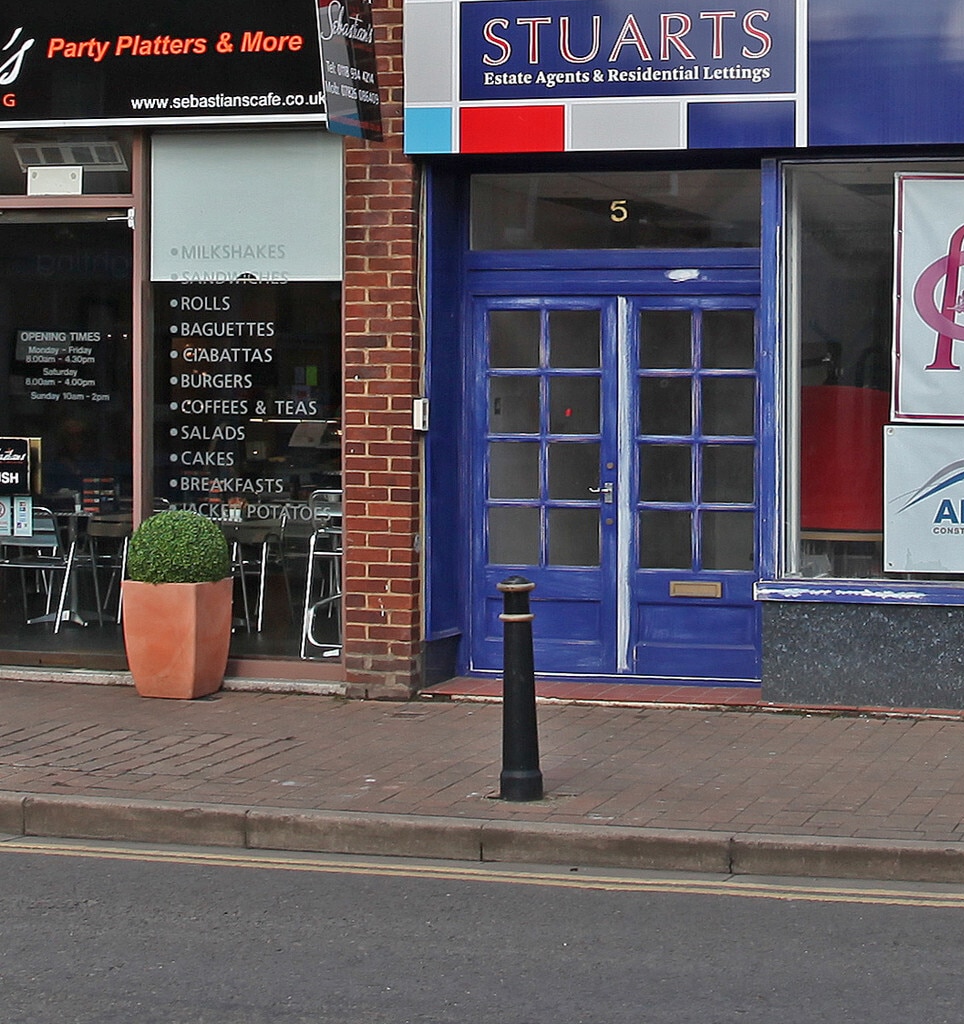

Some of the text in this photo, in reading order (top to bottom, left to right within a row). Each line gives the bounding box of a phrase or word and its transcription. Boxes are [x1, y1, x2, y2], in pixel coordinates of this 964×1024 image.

[482, 9, 773, 67] STUARTS
[48, 37, 111, 62] Party
[115, 34, 207, 56] Platters
[216, 32, 234, 53] &
[240, 31, 303, 53] More
[483, 63, 771, 88] Estate Agents & Residential Lettings
[131, 92, 326, 110] www.sebastianscafe.co.uk
[610, 200, 628, 222] 5
[181, 244, 286, 260] MILKSHAKES
[181, 296, 231, 311] ROLLS
[20, 332, 101, 342] OPENING TIMES
[180, 322, 275, 337] BAGUETTES
[28, 346, 60, 355] Monday
[68, 346, 92, 355] Friday
[183, 348, 273, 363] CIABATTAS
[42, 368, 78, 377] Saturday
[181, 373, 253, 389] BURGERS
[30, 391, 60, 401] Sunday
[62, 392, 85, 400] 10am
[91, 392, 110, 401] 2pm
[181, 399, 318, 415] COFFEES & TEAS
[181, 425, 246, 441] SALADS
[181, 451, 235, 466] CAKES
[0, 471, 19, 484] SH
[180, 477, 284, 493] BREAKFASTS
[247, 504, 332, 521] POTATOES
